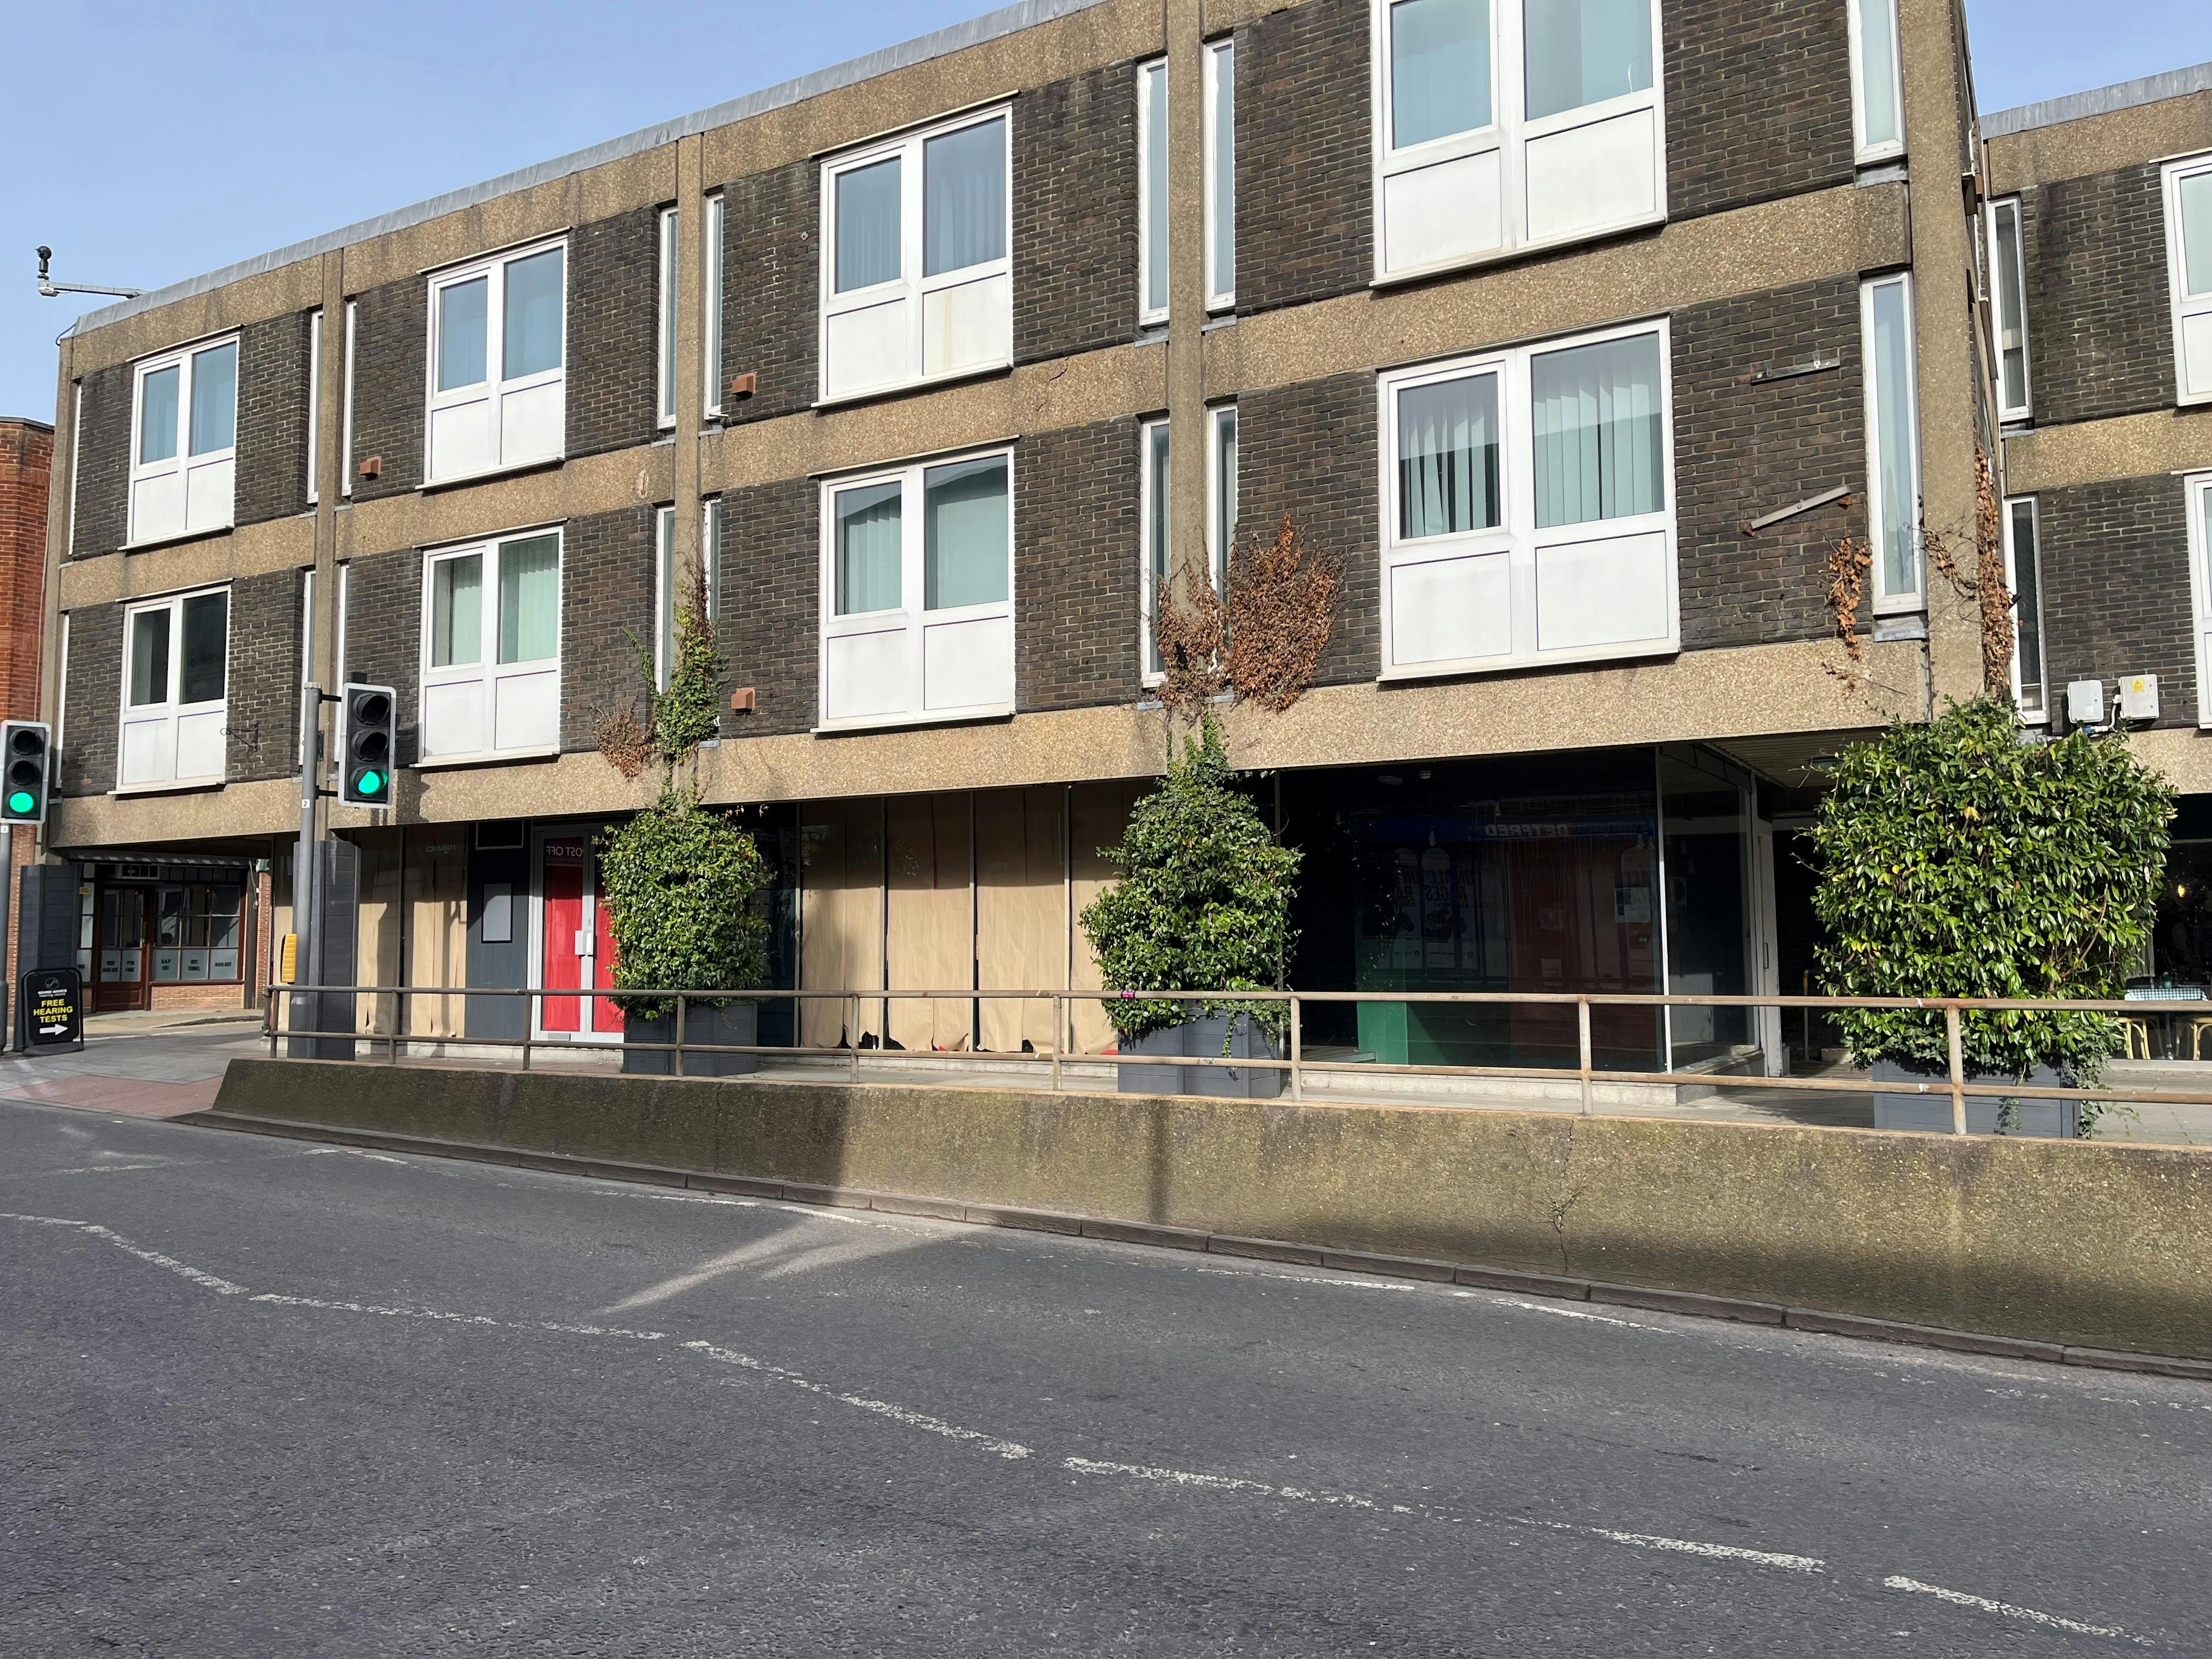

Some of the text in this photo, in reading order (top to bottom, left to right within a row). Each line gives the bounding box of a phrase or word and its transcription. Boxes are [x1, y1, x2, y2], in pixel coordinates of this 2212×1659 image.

[41, 998, 65, 1007] FREE
[33, 1006, 74, 1016] HEARING
[39, 1014, 68, 1023] TESTS
